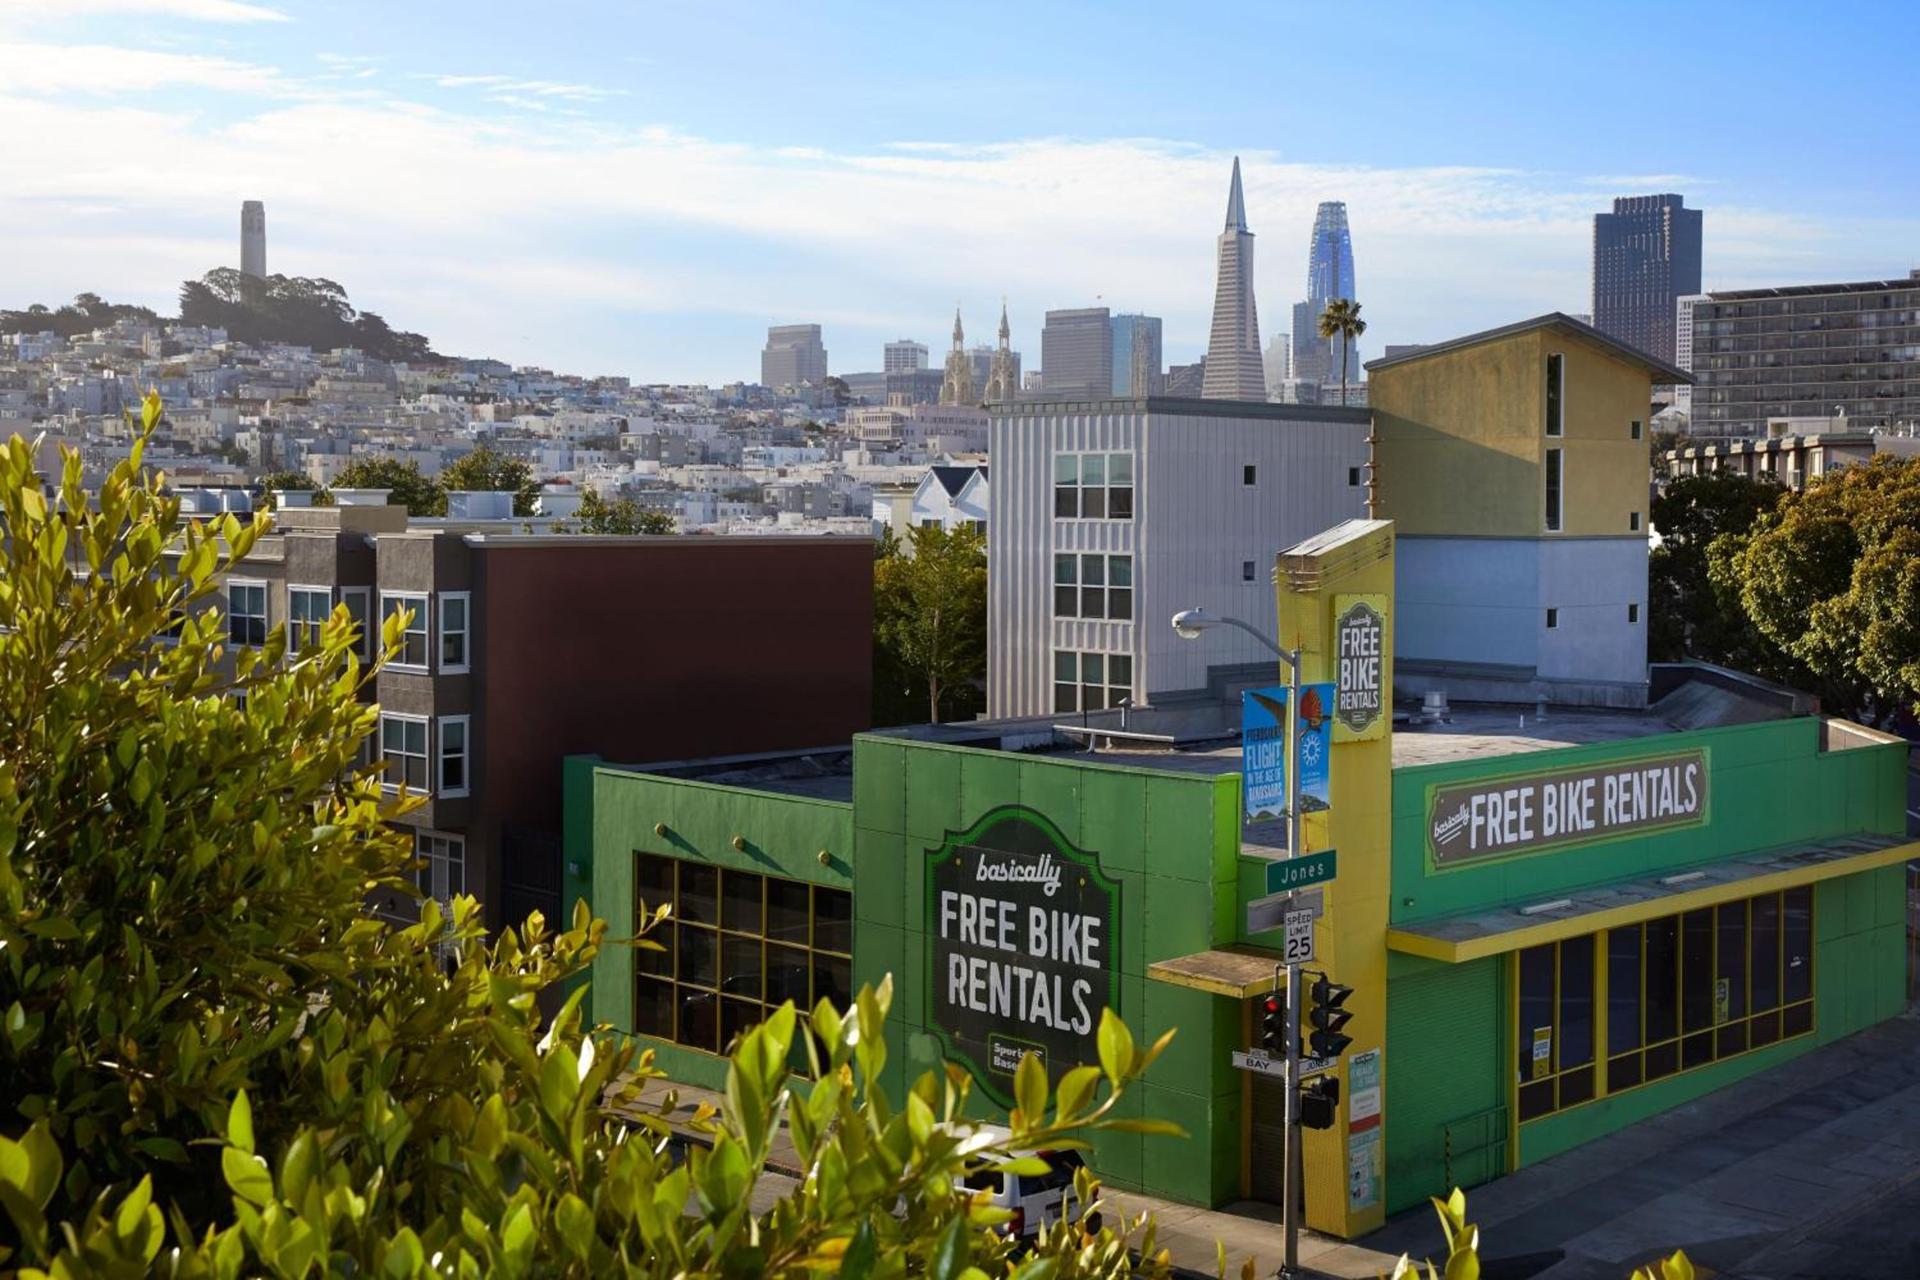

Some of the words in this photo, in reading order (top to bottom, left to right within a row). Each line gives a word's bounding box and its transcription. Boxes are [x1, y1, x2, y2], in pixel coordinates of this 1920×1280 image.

[1340, 627, 1380, 657] FREE
[1340, 657, 1379, 691] BIKE
[1340, 691, 1379, 710] RENTALS
[1254, 771, 1265, 784] THE
[1265, 769, 1274, 782] AGE
[1434, 803, 1470, 837] basically
[1470, 787, 1534, 849] FREE
[1543, 778, 1595, 837] BIKE
[1603, 763, 1697, 826] RENTALS
[976, 853, 1062, 896] basically
[1281, 863, 1324, 884] Jones
[941, 890, 1017, 952] FREE
[1028, 906, 1101, 969] BIKE
[1287, 913, 1311, 926] SPEED
[1289, 925, 1309, 936] LIMIT
[1288, 937, 1311, 958] 25
[949, 953, 1092, 1035] RENTALS
[1246, 1058, 1270, 1070] BAY
